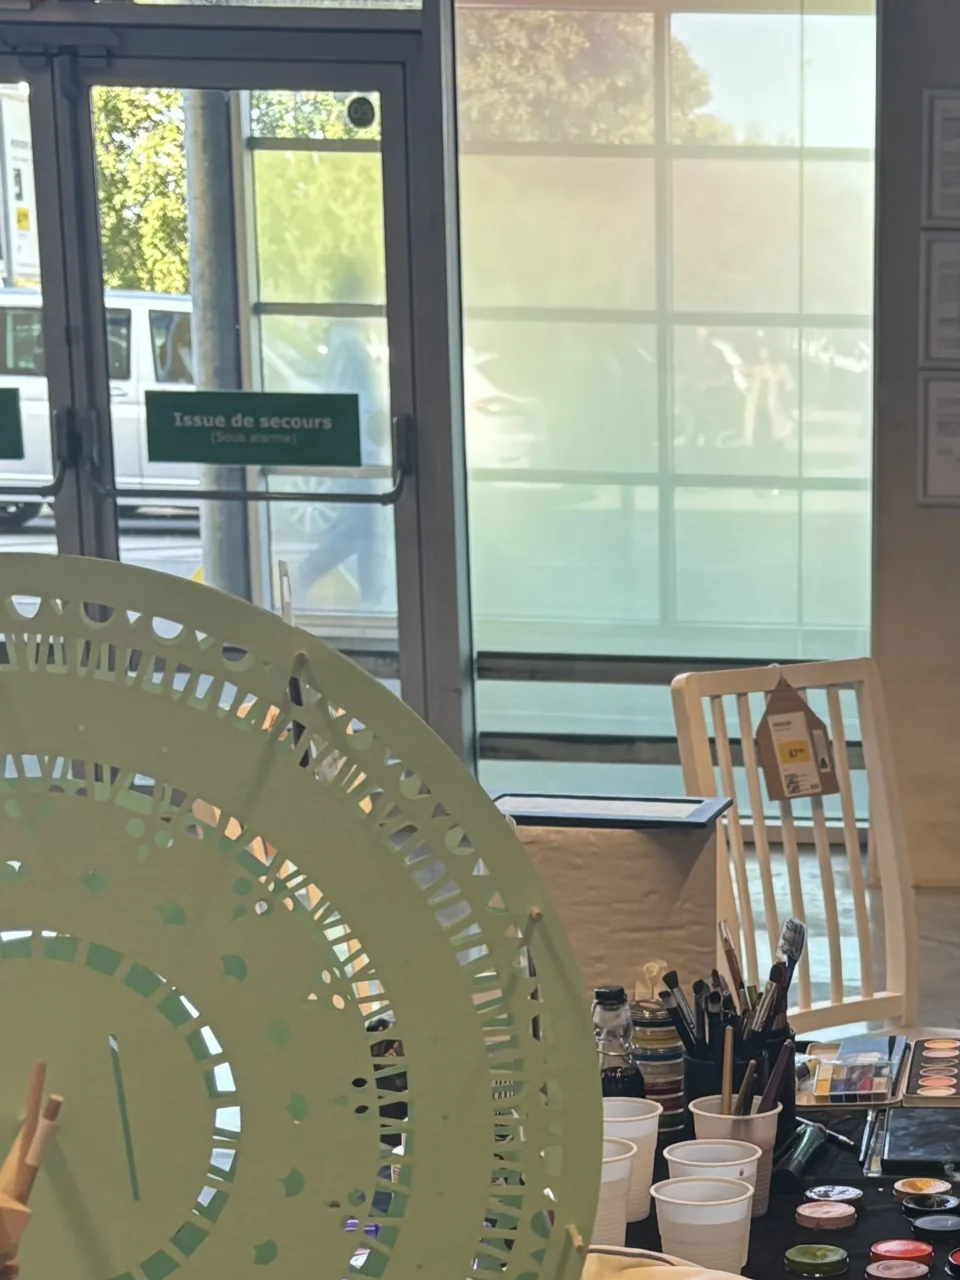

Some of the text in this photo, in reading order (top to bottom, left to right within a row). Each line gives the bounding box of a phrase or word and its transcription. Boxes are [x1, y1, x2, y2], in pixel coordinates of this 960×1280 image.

[173, 412, 332, 430] Issue de secours
